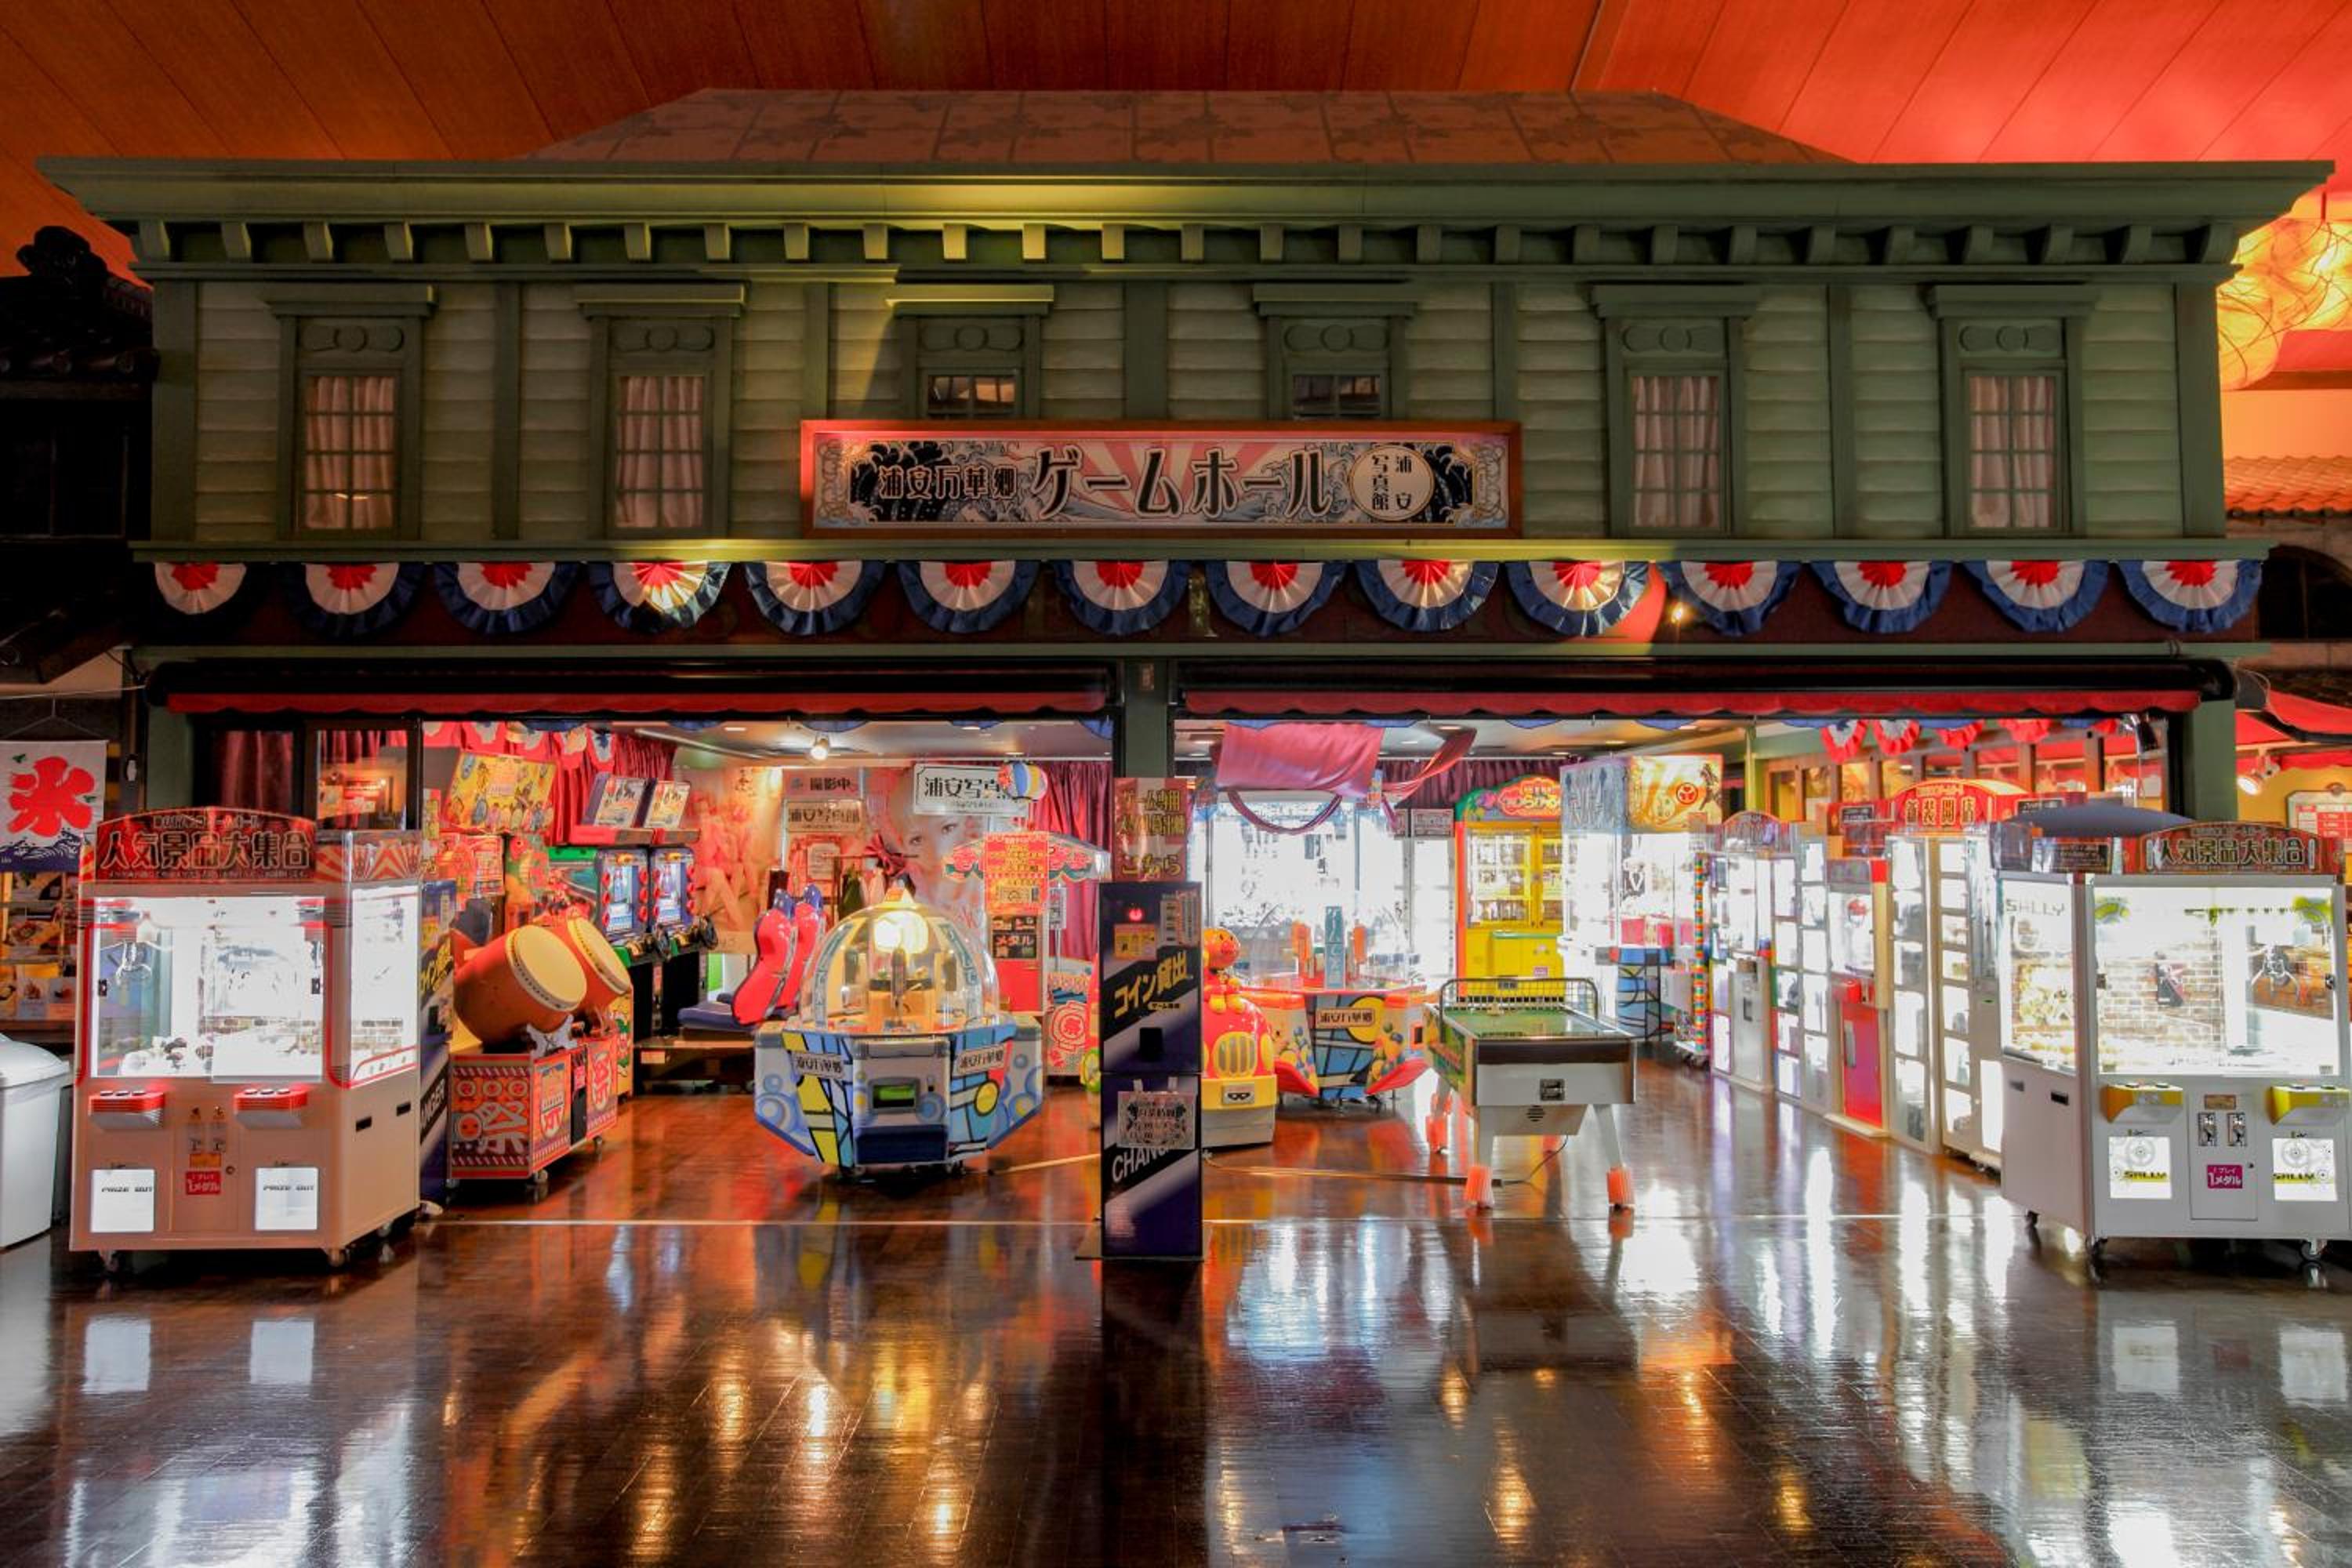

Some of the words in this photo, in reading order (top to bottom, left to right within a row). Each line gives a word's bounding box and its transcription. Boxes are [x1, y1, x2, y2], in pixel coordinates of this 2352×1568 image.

[1031, 445, 1332, 517] ゲームホール
[1371, 455, 1389, 511] 写真館
[8, 756, 95, 837] 氷
[924, 777, 1007, 799] 浦安写真
[100, 831, 310, 869] 人気景品大集合
[2158, 837, 2307, 865] 人気景品大集合
[1112, 1147, 1170, 1182] CHAN
